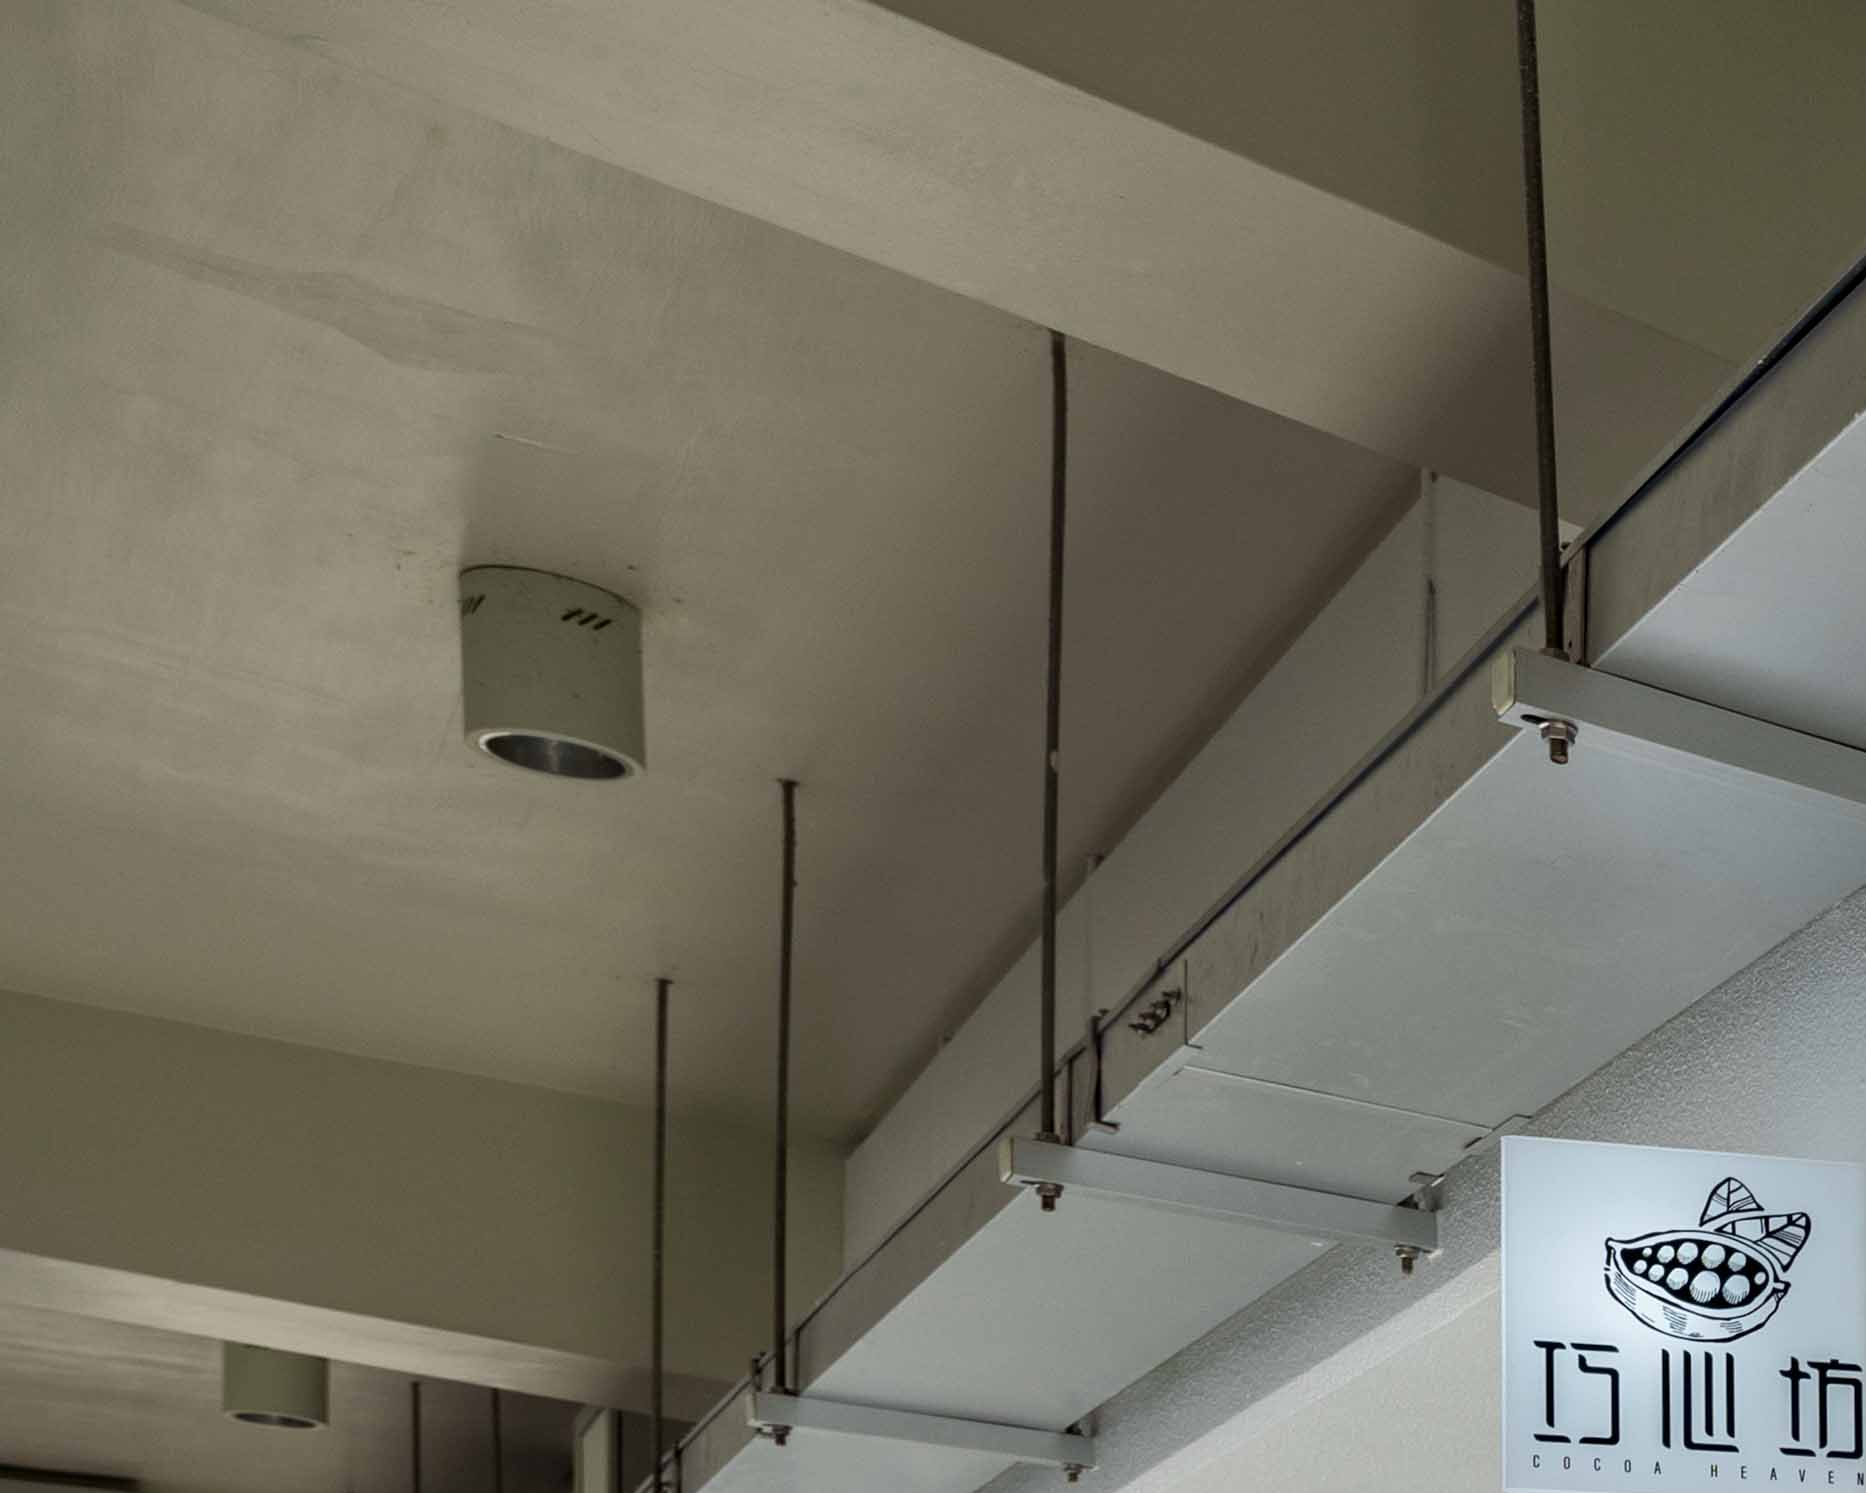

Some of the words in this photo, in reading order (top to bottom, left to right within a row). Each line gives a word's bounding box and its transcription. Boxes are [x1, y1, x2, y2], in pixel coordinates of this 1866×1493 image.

[1533, 1340, 1863, 1460] 巧心坊
[1532, 1454, 1662, 1475] COCOA
[1710, 1463, 1865, 1487] HEAVEN
